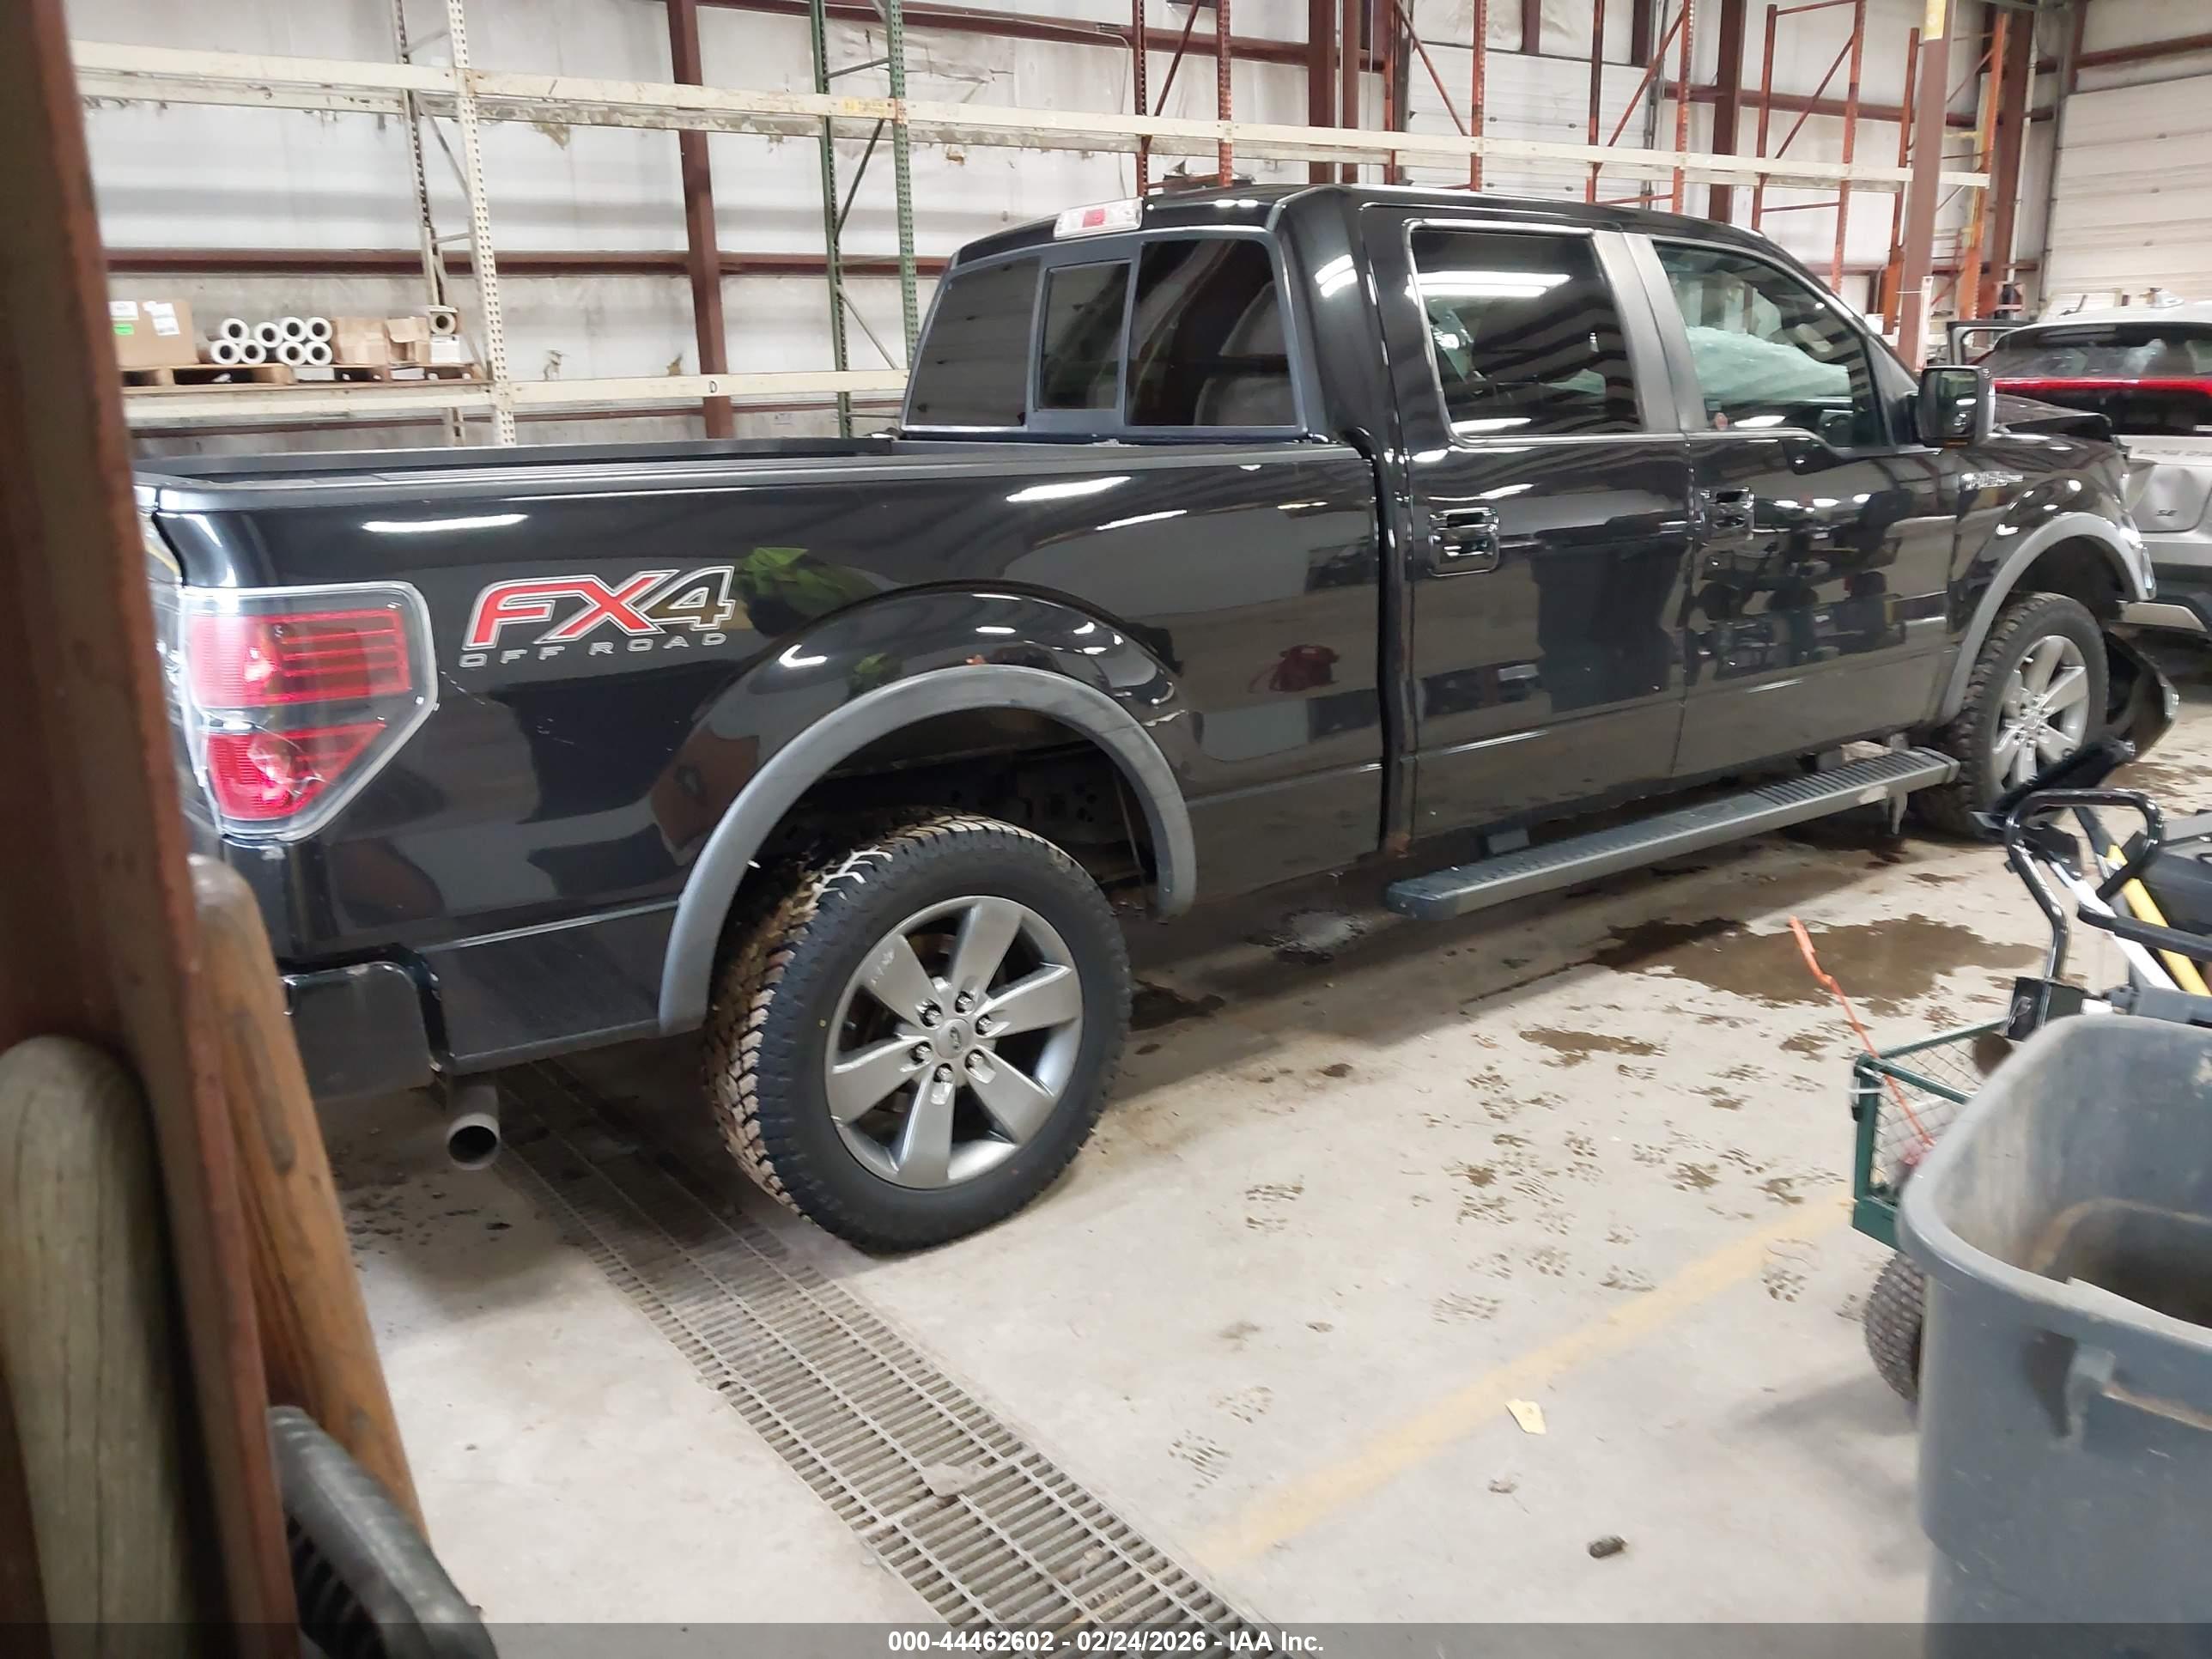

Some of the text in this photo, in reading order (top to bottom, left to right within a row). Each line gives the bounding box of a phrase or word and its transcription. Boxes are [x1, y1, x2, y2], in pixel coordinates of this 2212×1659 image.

[460, 564, 737, 651] FX4
[458, 632, 727, 668] OFF ROAD
